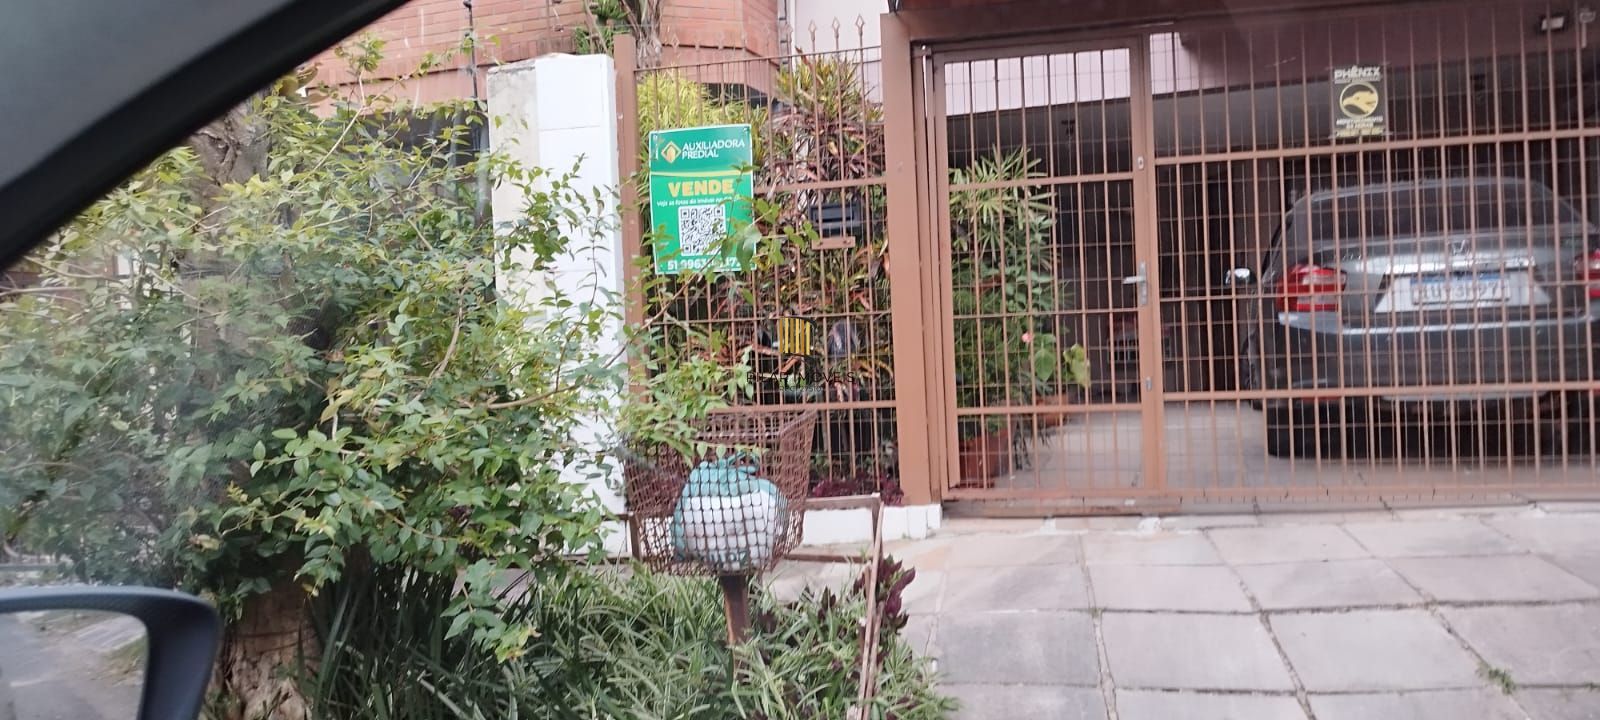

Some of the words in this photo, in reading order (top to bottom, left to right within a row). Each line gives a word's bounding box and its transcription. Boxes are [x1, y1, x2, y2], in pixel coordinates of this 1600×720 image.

[682, 139, 745, 151] AUXILIADORA
[682, 149, 719, 160] PREDIAL
[668, 179, 734, 197] VENDE
